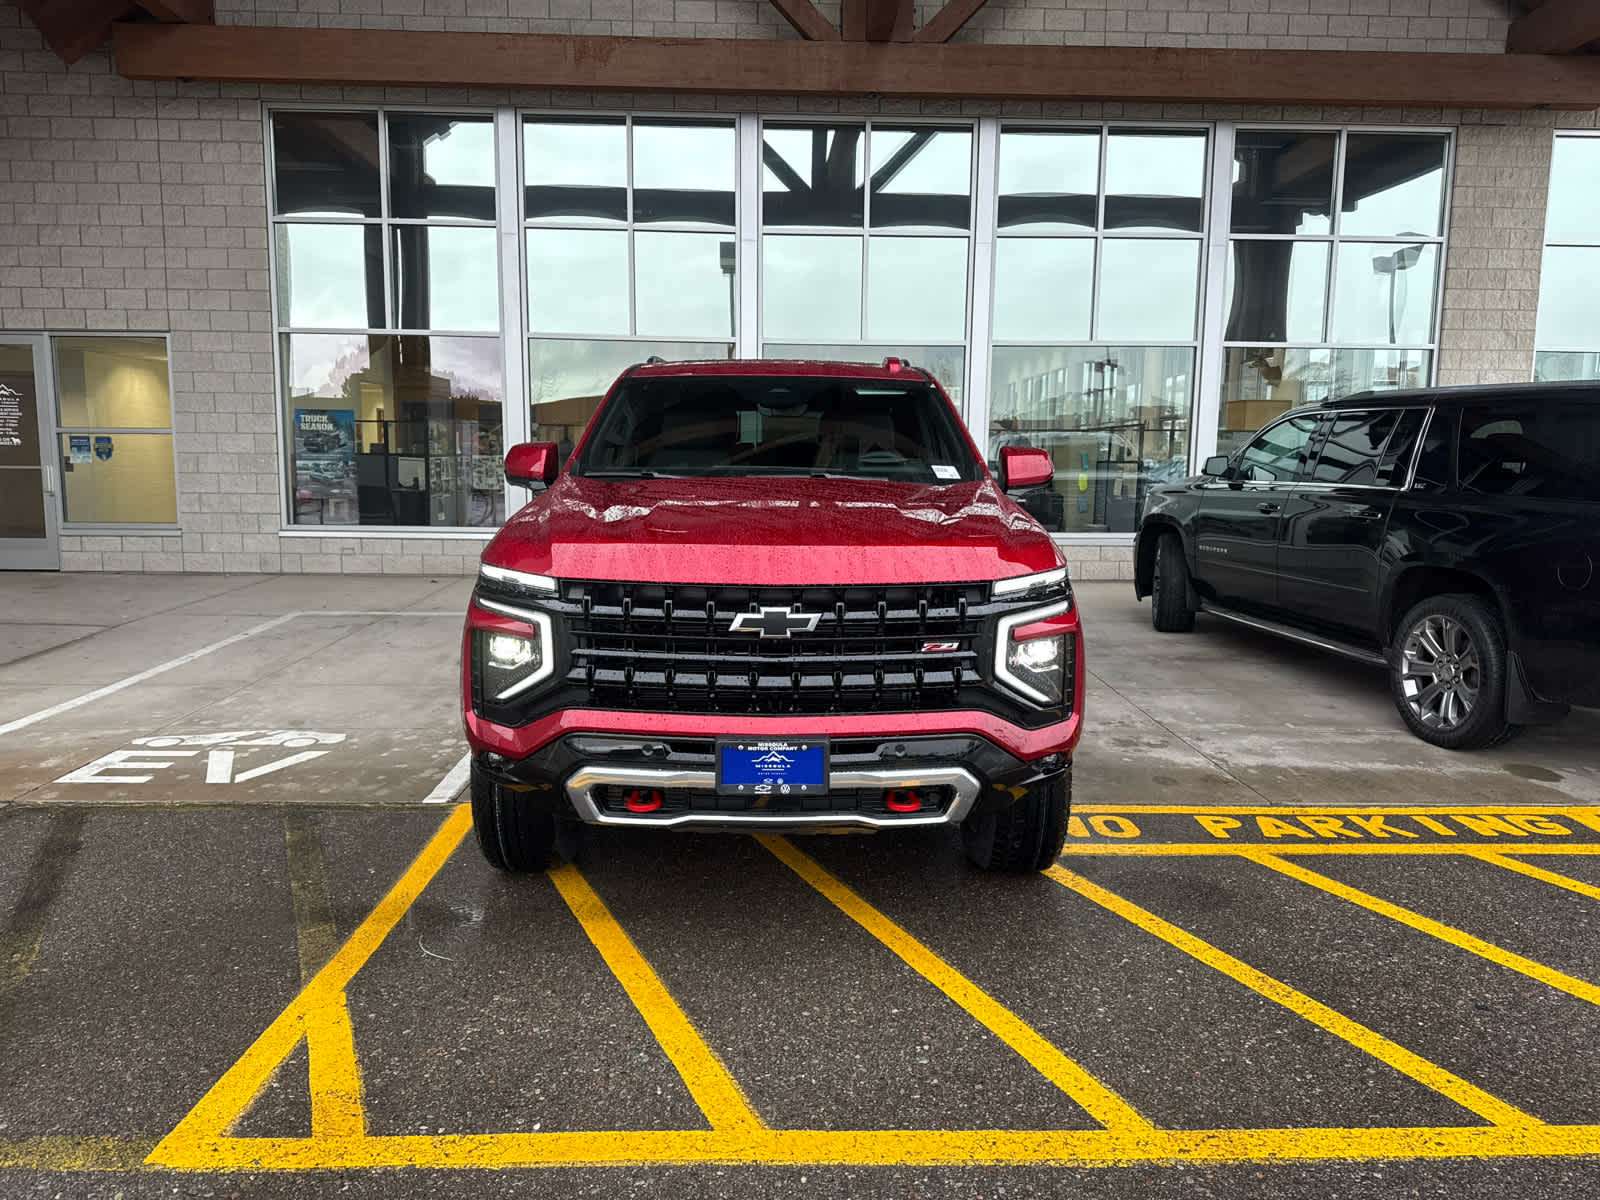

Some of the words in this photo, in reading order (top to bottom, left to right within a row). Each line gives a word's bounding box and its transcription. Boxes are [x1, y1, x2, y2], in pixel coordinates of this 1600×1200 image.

[299, 414, 329, 423] TRUCK
[300, 422, 334, 431] SEASON
[52, 750, 330, 784] EV
[1193, 815, 1573, 838] PARKING
